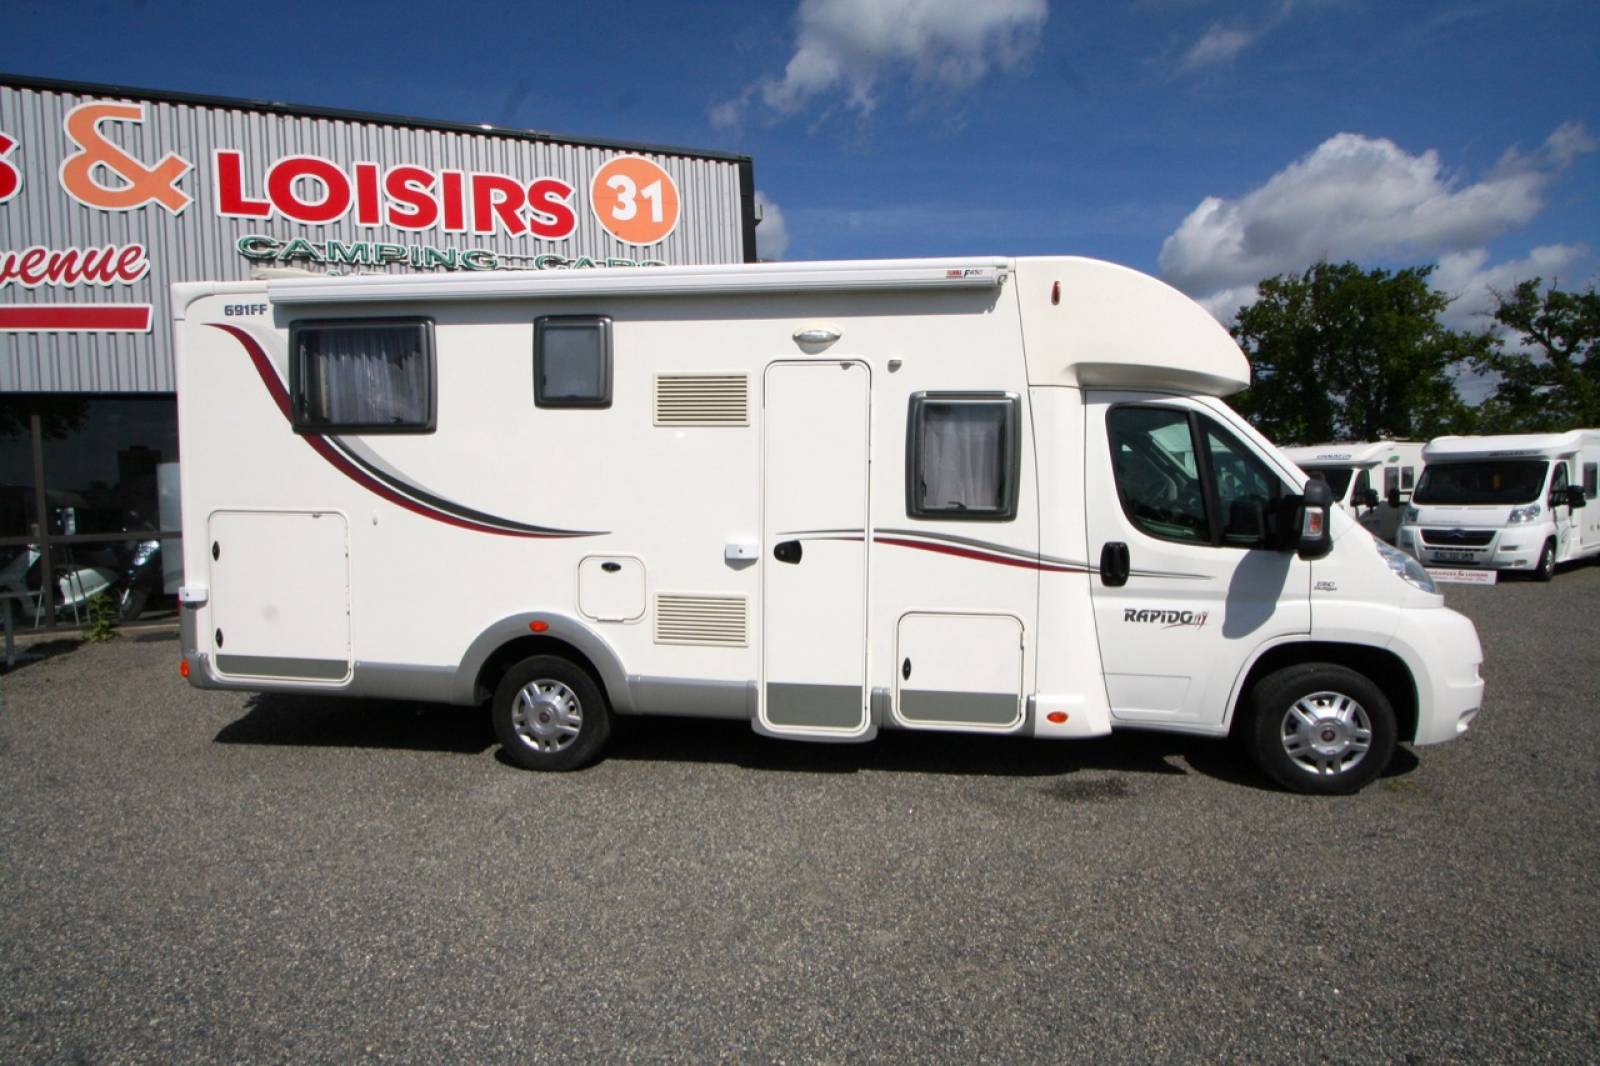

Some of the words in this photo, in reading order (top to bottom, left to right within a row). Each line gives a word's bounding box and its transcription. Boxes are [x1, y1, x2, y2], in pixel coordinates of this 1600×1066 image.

[59, 100, 194, 216] &
[215, 148, 578, 242] LOISIRS
[605, 173, 665, 223] 31
[237, 234, 498, 271] CAMPING
[534, 254, 669, 270] CA
[224, 304, 267, 316] 691FF
